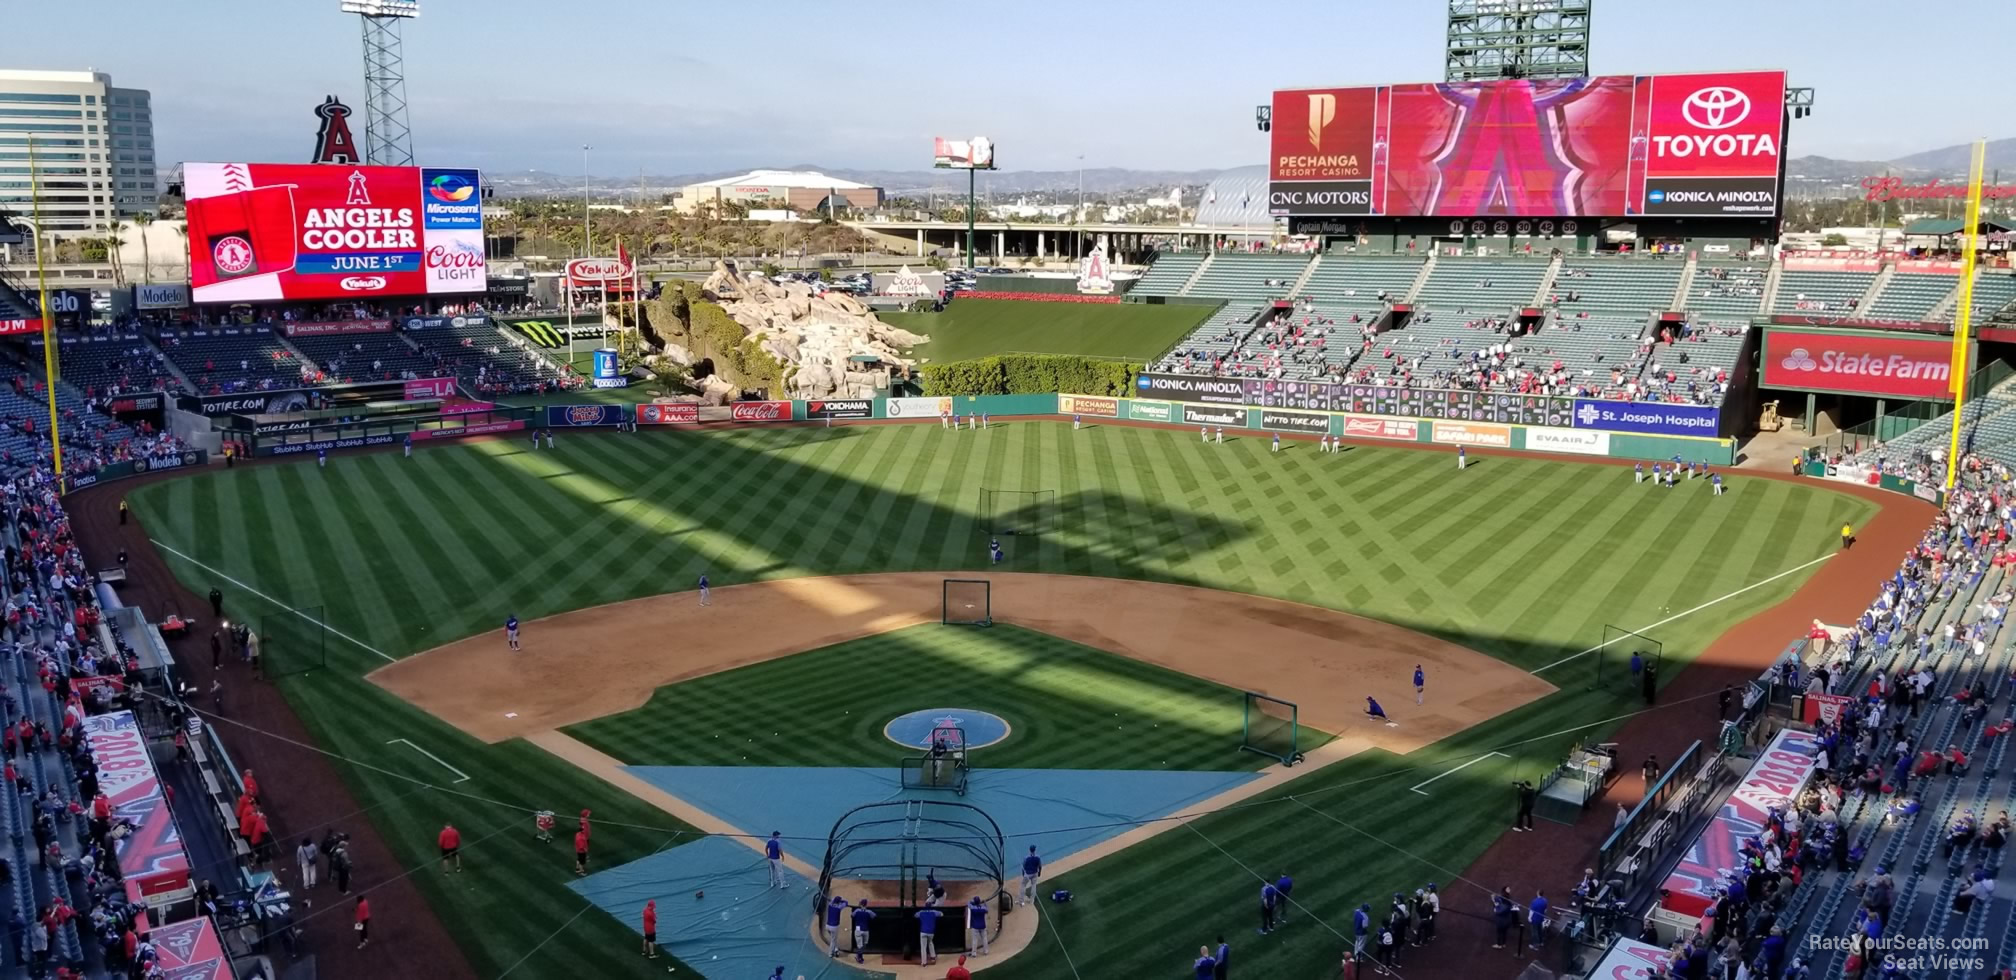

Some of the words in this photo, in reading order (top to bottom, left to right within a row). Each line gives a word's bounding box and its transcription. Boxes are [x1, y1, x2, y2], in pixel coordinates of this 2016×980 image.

[1652, 133, 1777, 157] TOYOTA
[1279, 155, 1358, 167] PECHANGA
[1279, 168, 1316, 176] RESORT
[1270, 192, 1302, 205] CNC
[1306, 191, 1369, 205] MOTORS
[1666, 191, 1715, 202] KONICA
[1717, 191, 1773, 202] MINOLTA
[303, 208, 414, 228] ANGELS
[1296, 221, 1321, 233] Captain
[1321, 221, 1347, 233] Morgan
[1453, 222, 1461, 231] 11
[1518, 222, 1530, 231] 30
[1540, 222, 1552, 231] 42
[1564, 222, 1576, 231] 50
[303, 229, 417, 250] COOLER
[426, 245, 484, 268] Coors
[331, 256, 380, 270] JUNE
[384, 256, 404, 269] 1ST
[438, 268, 477, 280] LIGHT
[892, 274, 924, 286] Coors
[142, 288, 182, 303] Modelo
[425, 319, 443, 327] WEST
[435, 382, 455, 397] LA
[1152, 378, 1193, 391] KONICA
[1195, 381, 1243, 394] MINOLTA
[1256, 381, 1261, 389] 3
[1367, 388, 1373, 396] 4
[1075, 400, 1116, 409] PECHANGA
[1488, 396, 1494, 404] 2
[1511, 397, 1520, 405] 11
[571, 405, 600, 415] Jersey
[733, 403, 781, 420] Coca-Cola
[1140, 405, 1169, 415] National
[1366, 404, 1371, 412] 6
[1185, 411, 1235, 423] Thermador
[1263, 415, 1289, 425] NITTO
[1486, 412, 1492, 420] 4
[1563, 417, 1569, 425] 4
[1602, 410, 1617, 421] St.
[1620, 412, 1663, 427] Joseph
[1665, 415, 1716, 429] Hospital
[274, 445, 303, 454] StubHub
[305, 443, 334, 451] StubHub
[336, 439, 364, 448] StubHub
[366, 436, 393, 445] StubHub
[1536, 434, 1562, 443] EVA
[1565, 435, 1583, 444] AIR
[150, 455, 181, 470] Modelo
[74, 474, 96, 488] Fanatics
[91, 731, 146, 772] 2018
[1745, 751, 1813, 796] 2018
